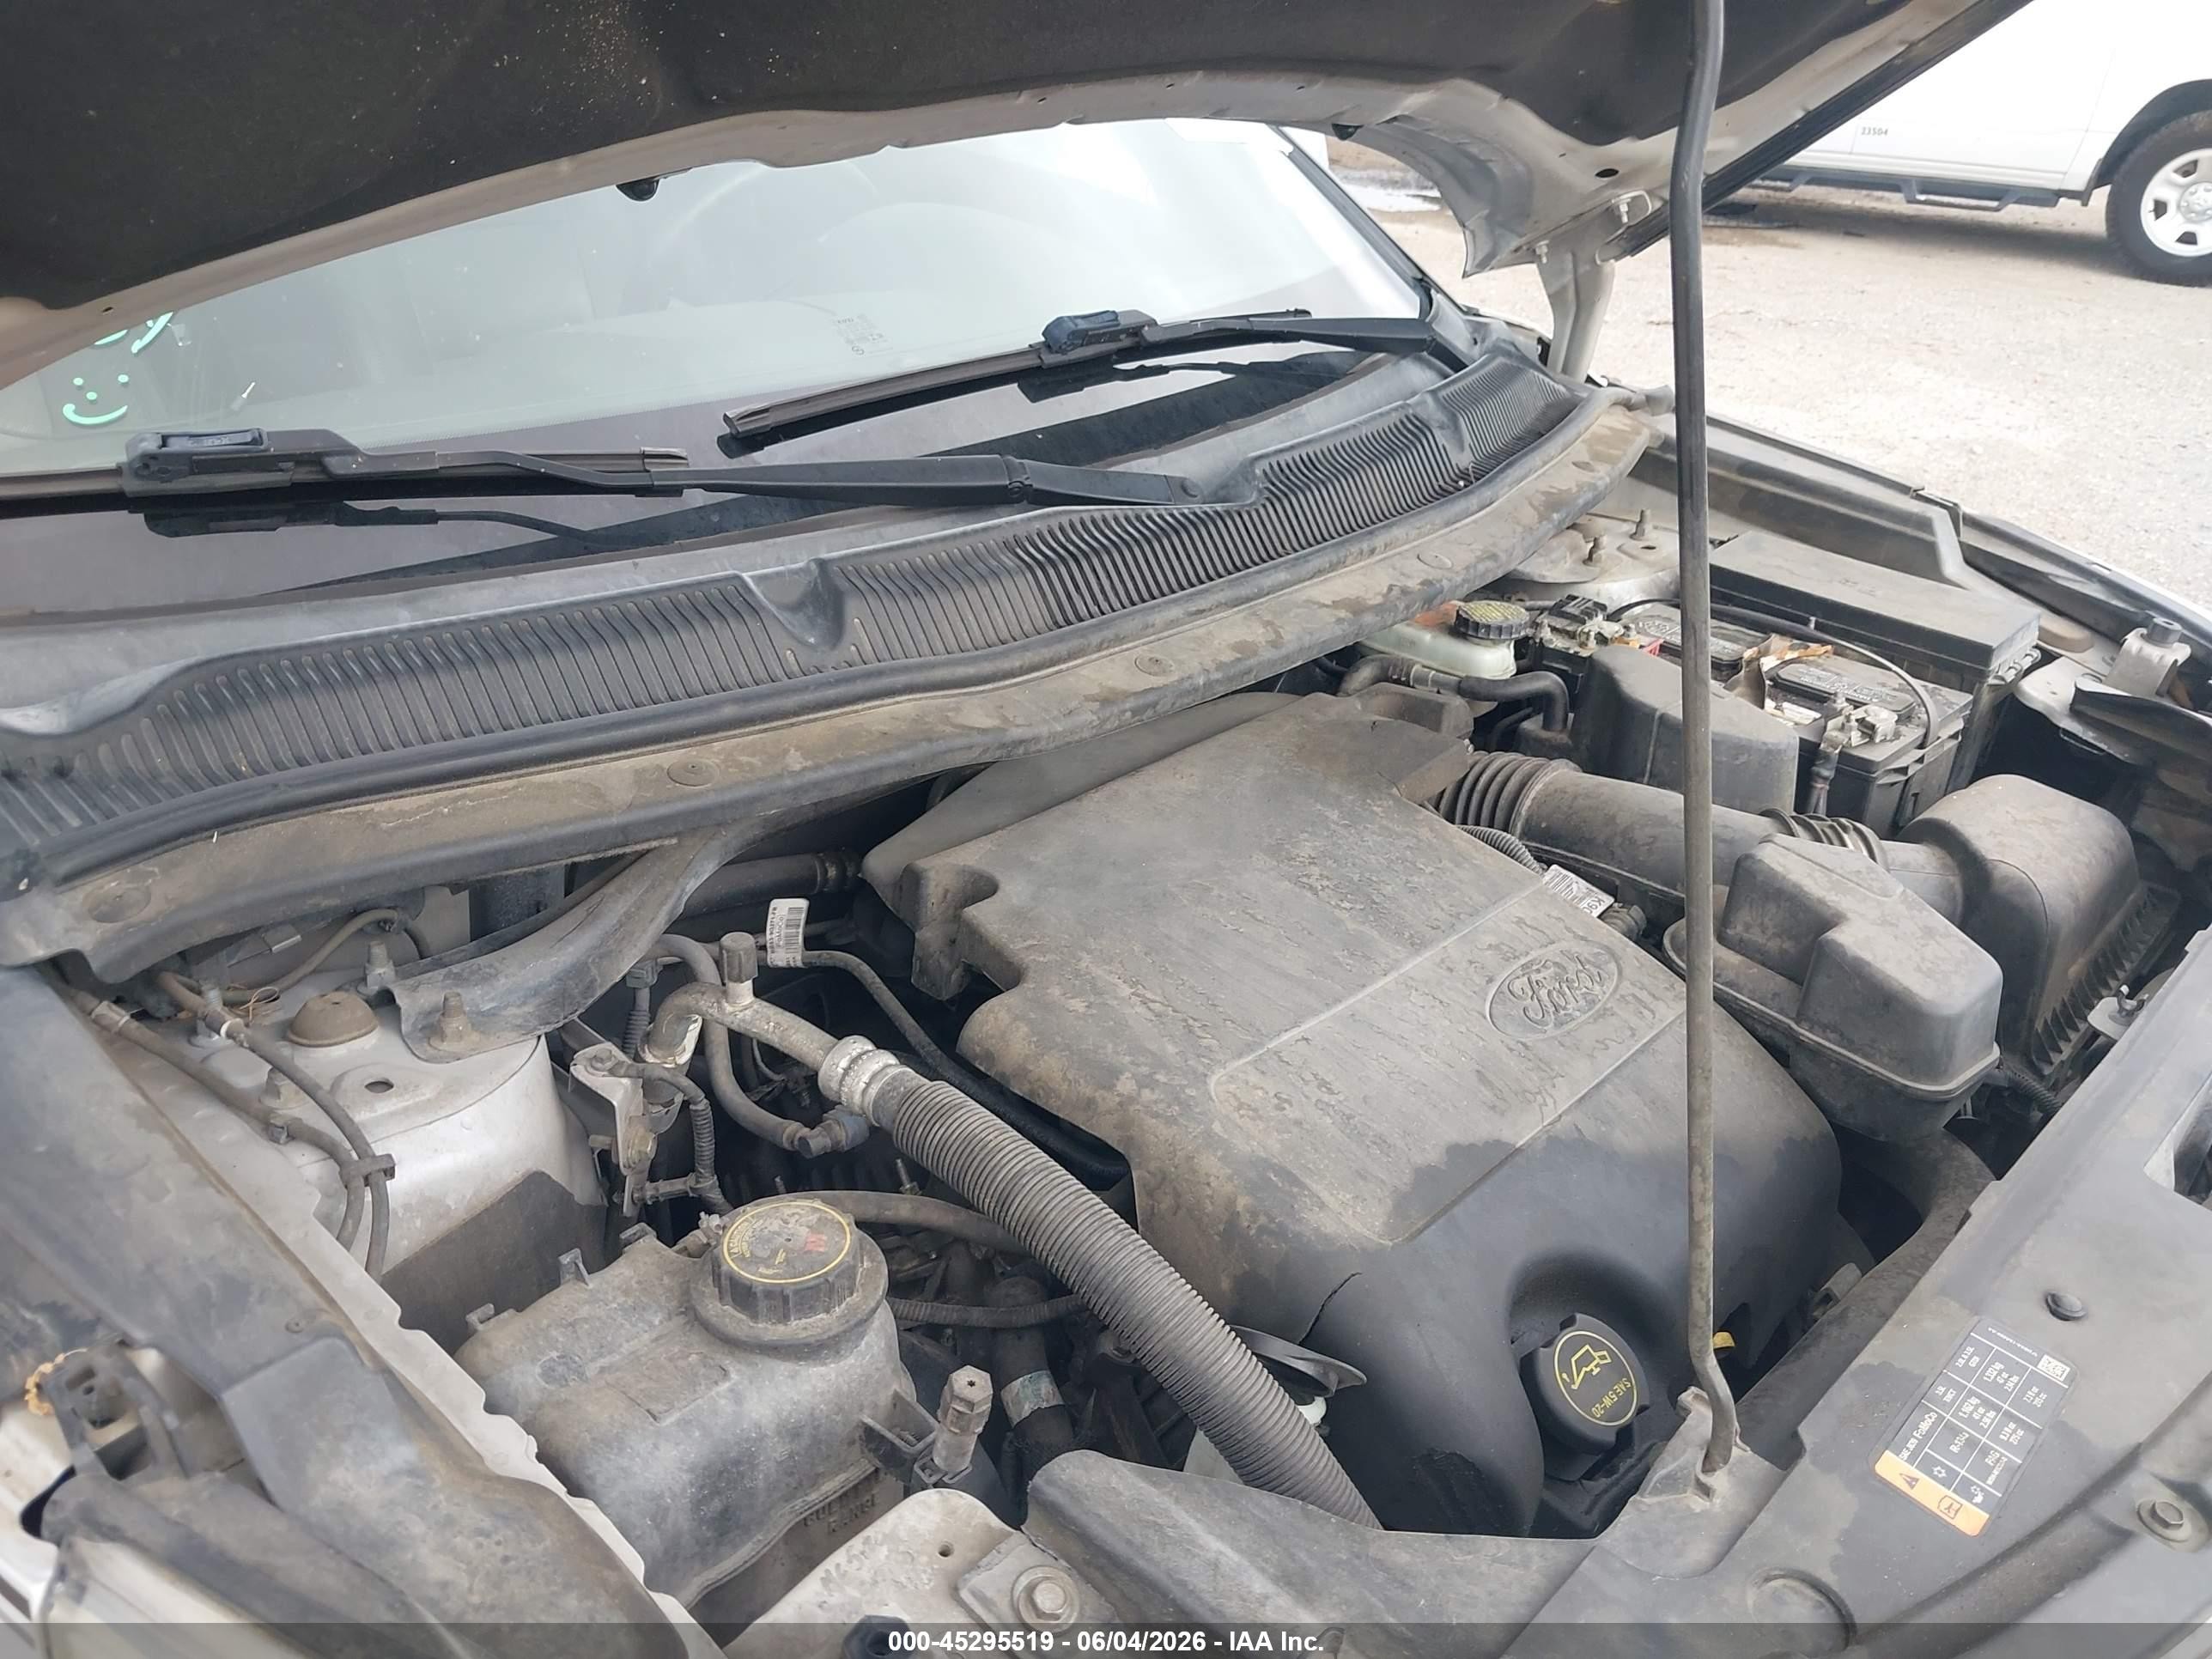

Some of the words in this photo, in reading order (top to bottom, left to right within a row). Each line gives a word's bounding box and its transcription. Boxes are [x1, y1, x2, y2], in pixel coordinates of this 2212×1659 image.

[1508, 949, 1604, 1030] Ford
[1613, 1377, 1632, 1396] SAE
[1591, 1392, 1619, 1418] 5W-20
[1912, 1412, 1938, 1439] FoMoCo
